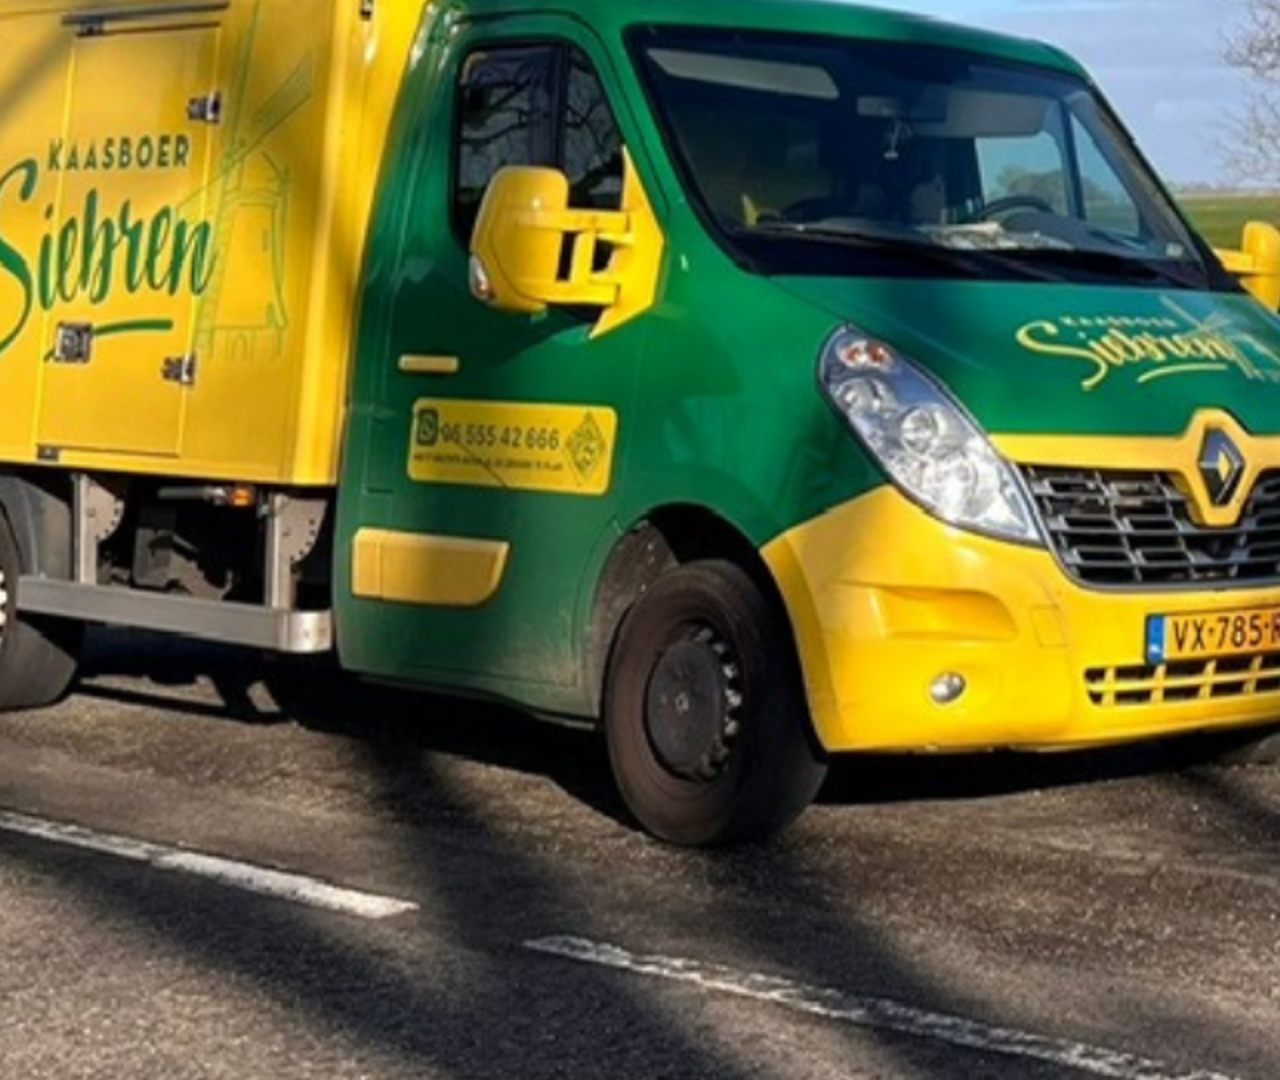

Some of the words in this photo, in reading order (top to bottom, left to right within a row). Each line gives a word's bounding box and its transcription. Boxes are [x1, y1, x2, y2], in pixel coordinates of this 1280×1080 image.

[47, 133, 191, 172] KAASBOER
[465, 424, 496, 447] 555
[500, 426, 523, 449] 42
[524, 427, 561, 451] 666
